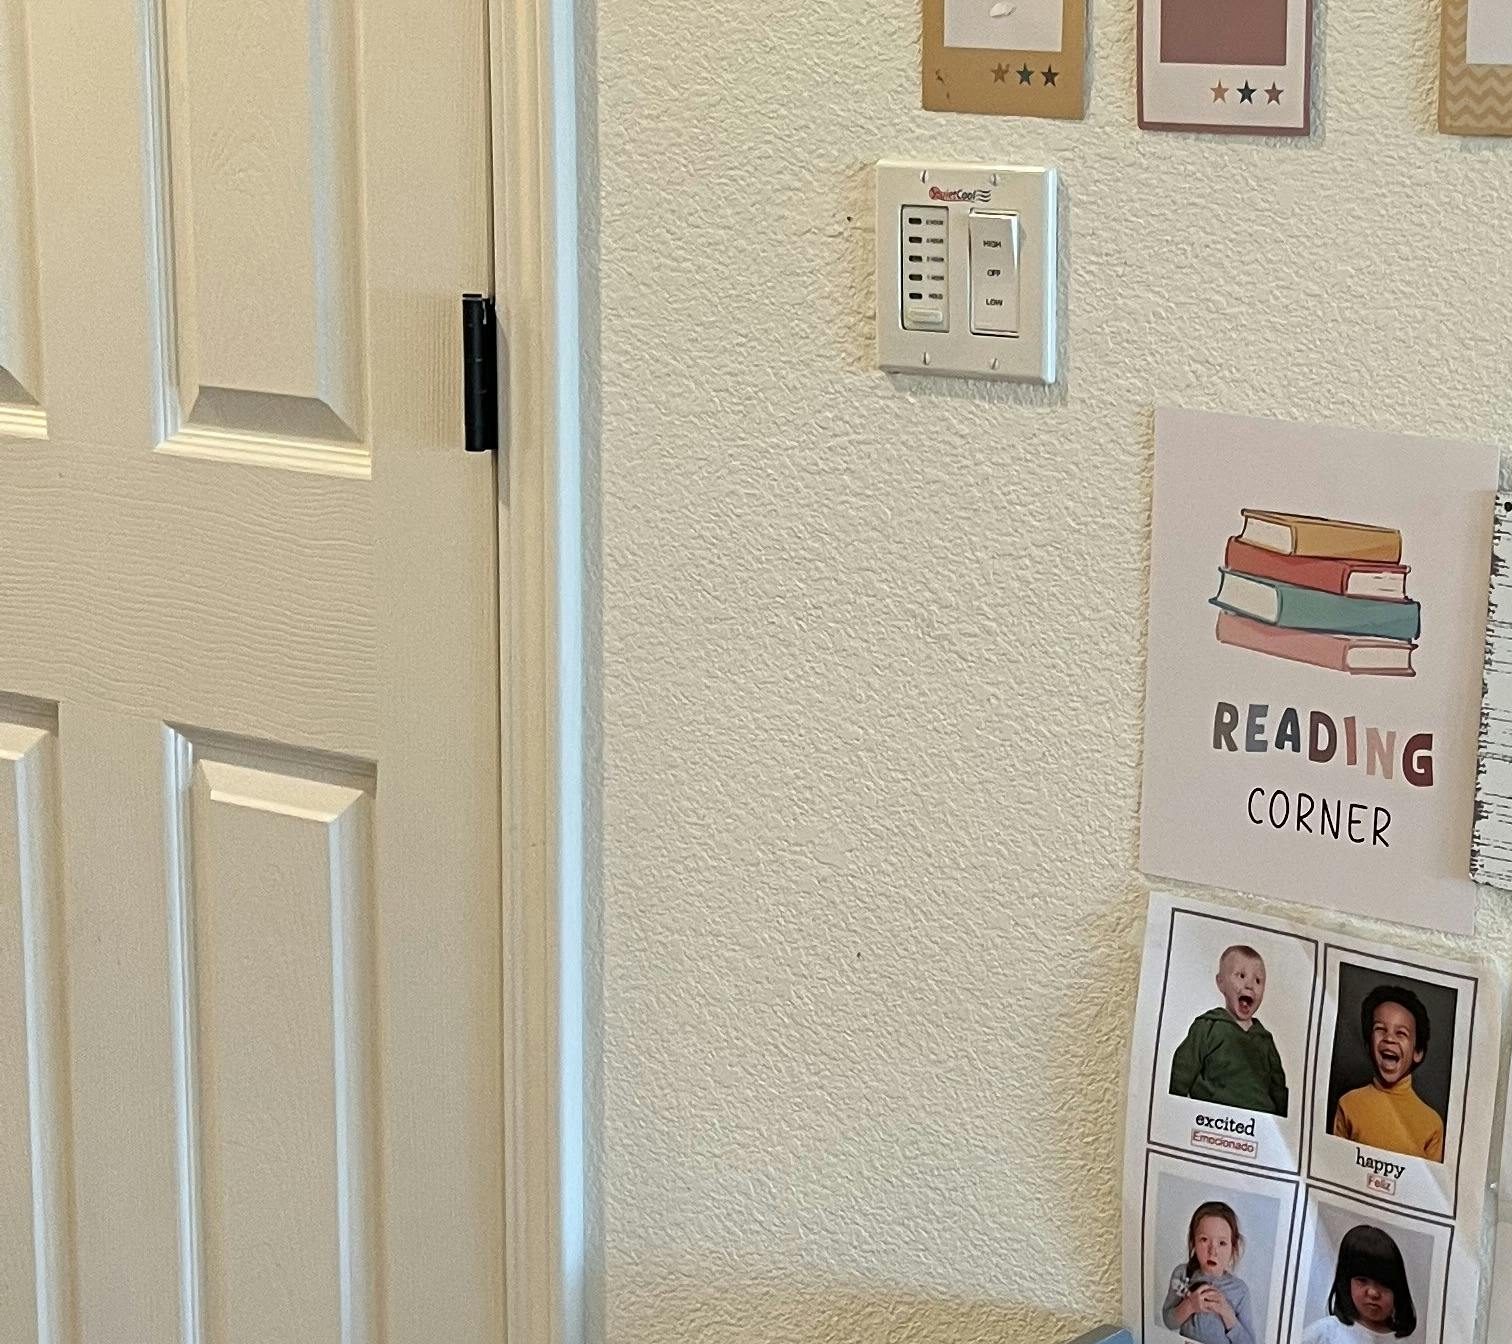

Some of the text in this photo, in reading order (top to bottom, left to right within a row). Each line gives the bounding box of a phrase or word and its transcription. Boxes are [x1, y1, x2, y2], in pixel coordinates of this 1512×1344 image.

[1213, 701, 1434, 787] READING
[1247, 787, 1391, 847] CORNER
[1195, 1112, 1256, 1137] excited
[1192, 1131, 1254, 1154] Emocionado
[1355, 1147, 1405, 1179] happy
[1367, 1176, 1391, 1191] Feliz
